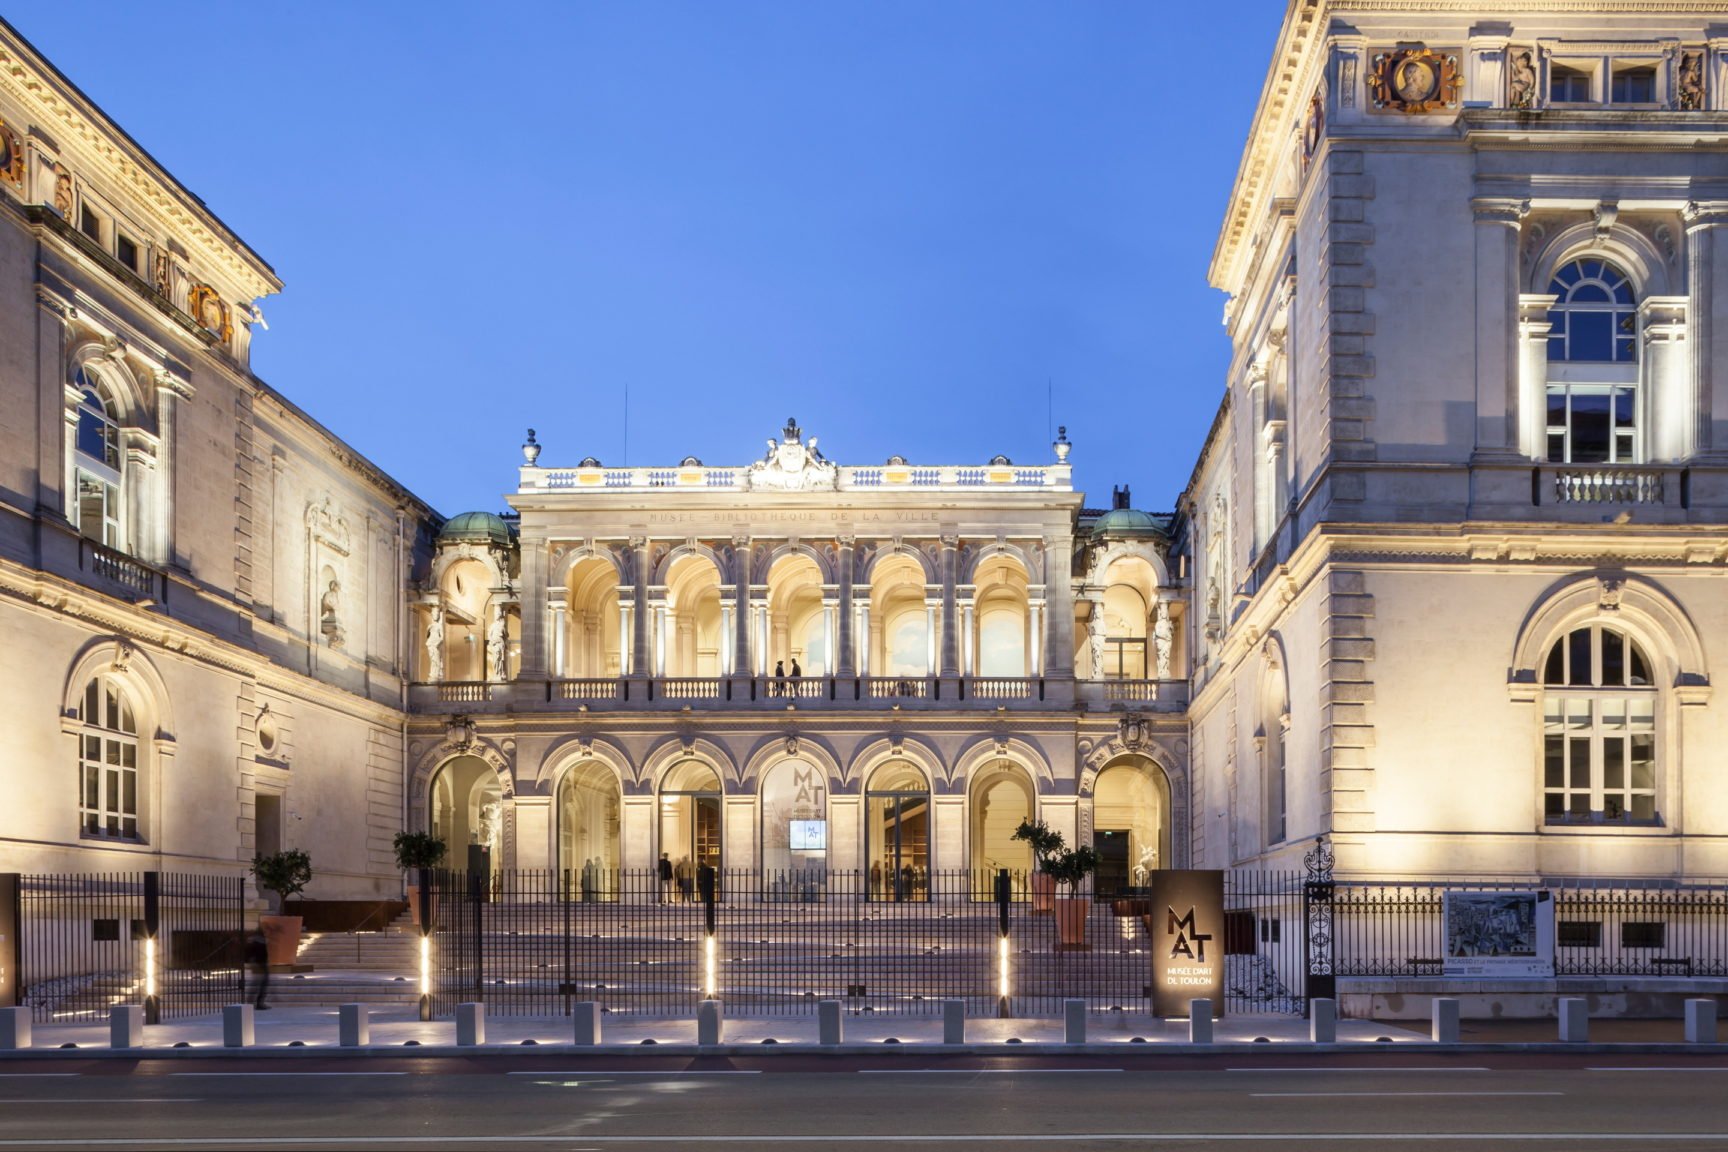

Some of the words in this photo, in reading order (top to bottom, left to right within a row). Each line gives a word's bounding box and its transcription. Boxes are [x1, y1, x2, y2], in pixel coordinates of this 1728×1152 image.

[831, 512, 848, 521] DE
[863, 512, 880, 521] LA
[895, 512, 939, 521] VILLE
[1167, 966, 1192, 975] MUSÉE
[1180, 976, 1212, 985] TOULON
